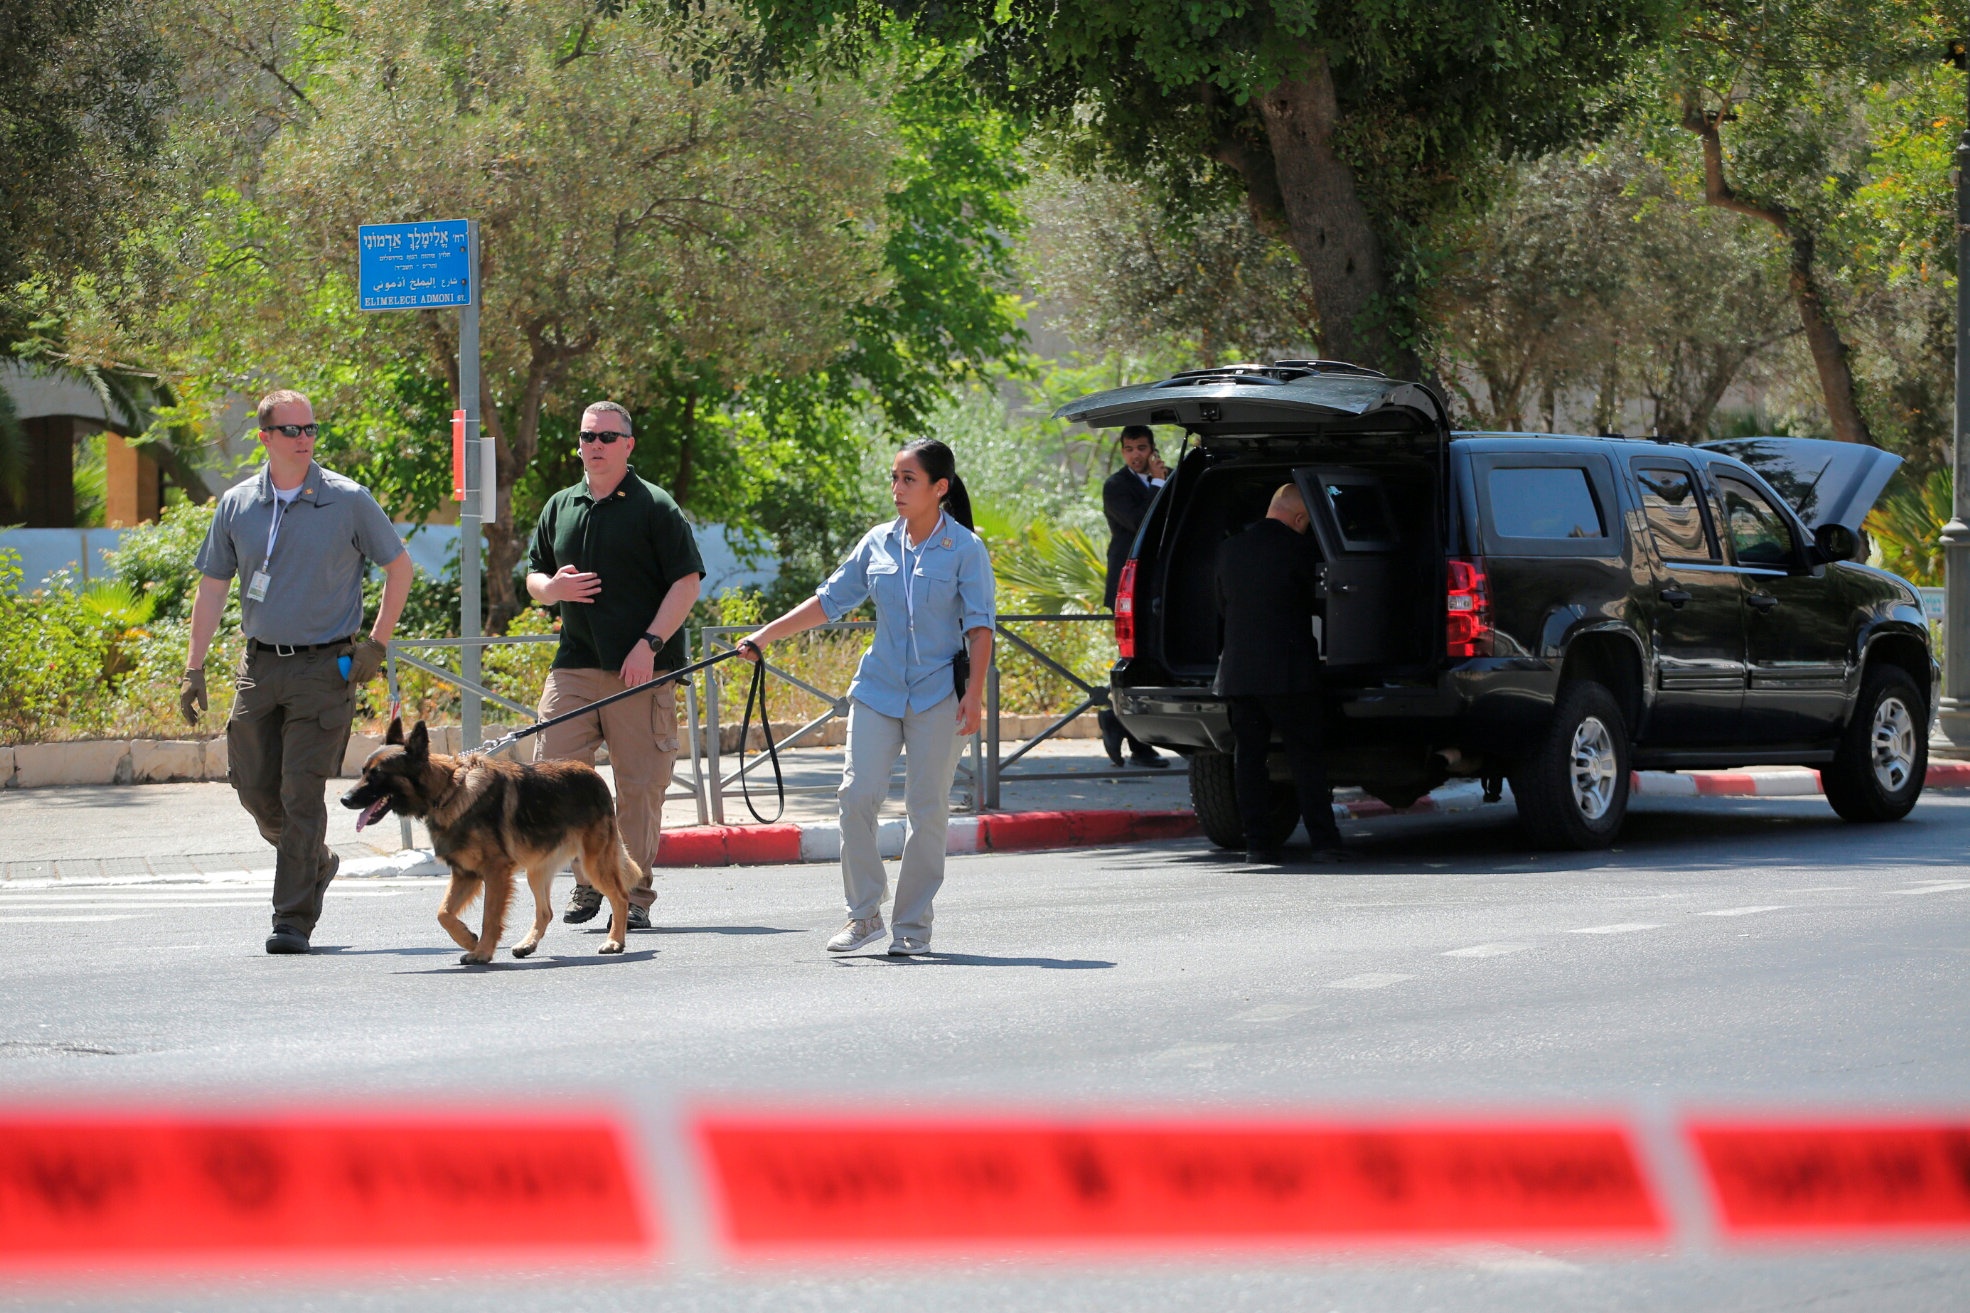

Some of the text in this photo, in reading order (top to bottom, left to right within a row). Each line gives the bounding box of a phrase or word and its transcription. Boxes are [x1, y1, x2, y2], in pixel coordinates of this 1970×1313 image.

[441, 278, 458, 288] شارع
[364, 295, 417, 306] ELIMELECH
[420, 293, 454, 303] ADMONI
